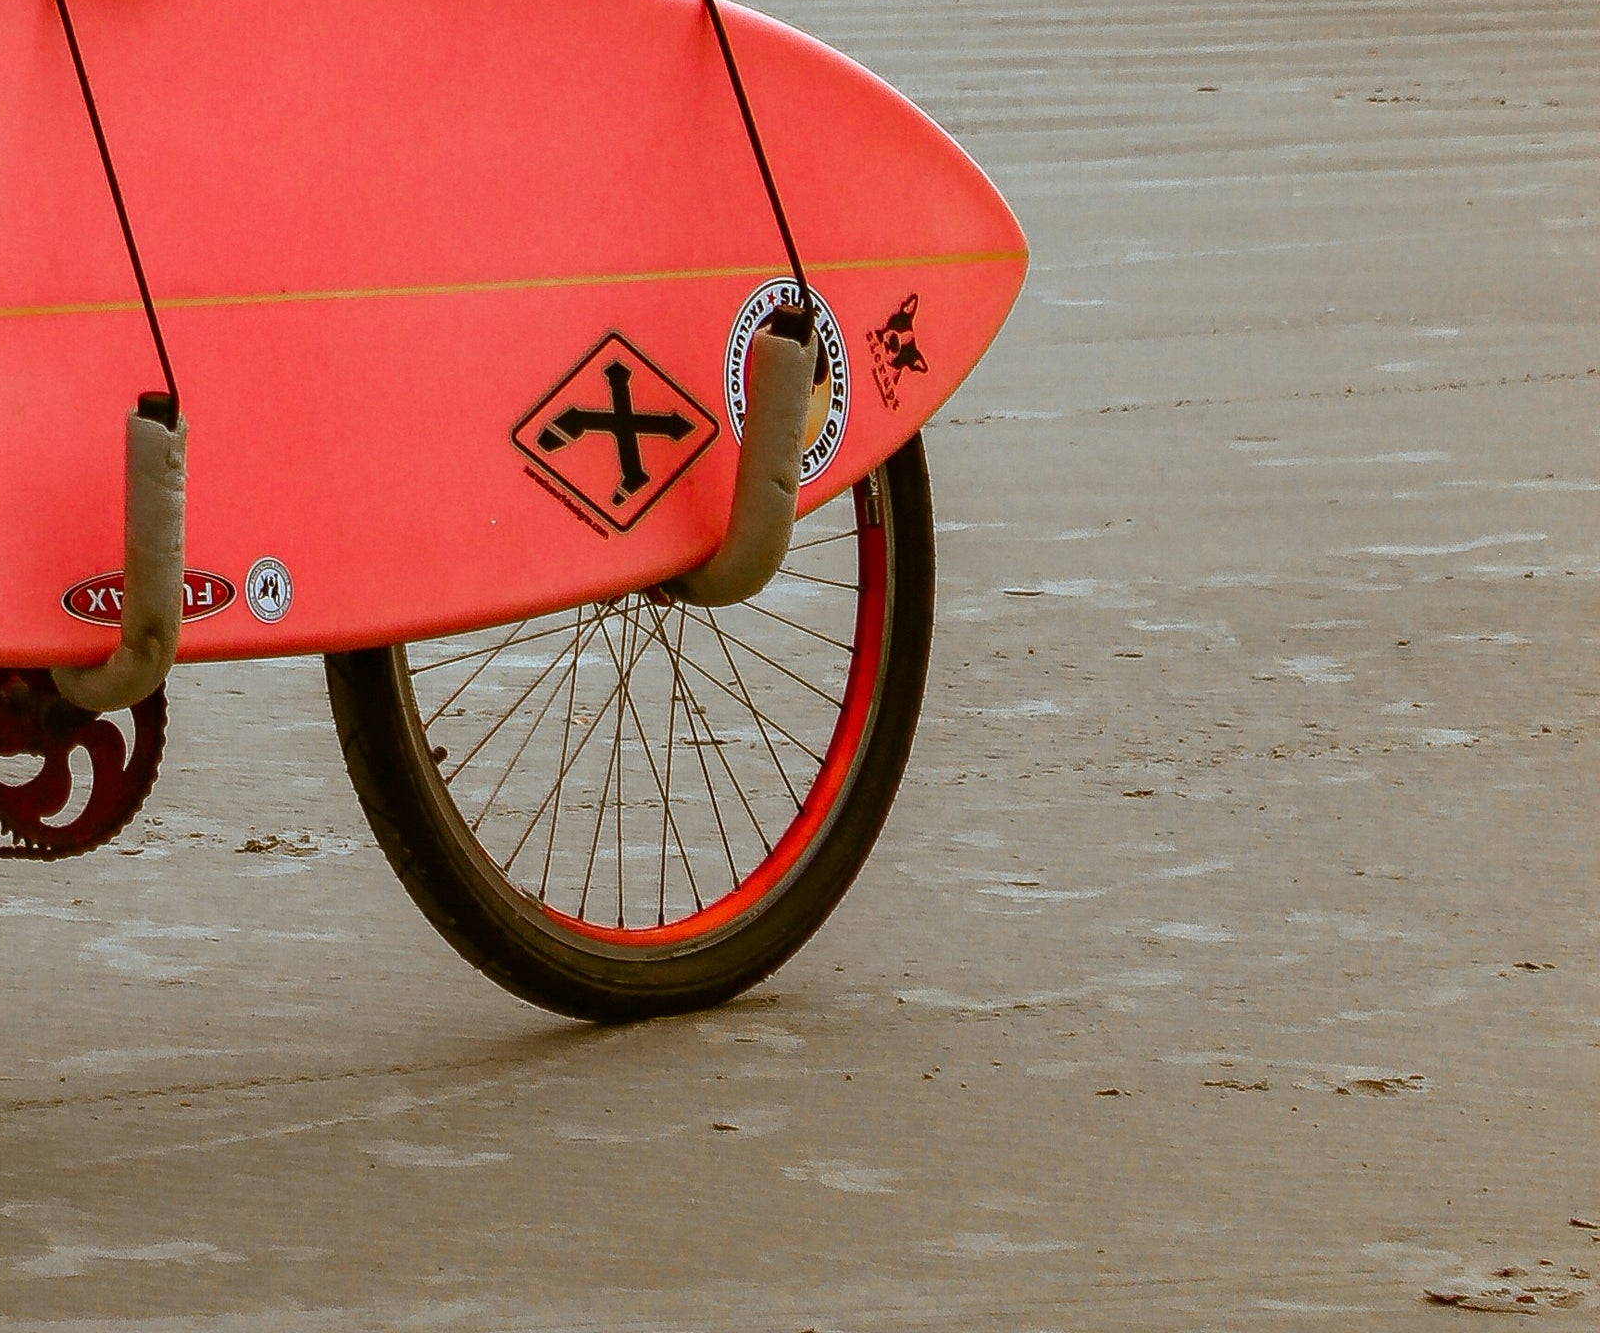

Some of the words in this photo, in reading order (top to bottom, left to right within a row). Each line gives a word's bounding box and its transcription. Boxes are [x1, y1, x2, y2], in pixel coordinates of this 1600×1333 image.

[780, 288, 821, 319] SUF
[731, 300, 764, 394] EXCLUSIVO
[820, 319, 844, 414] HOUSE
[802, 423, 838, 473] GIRLS
